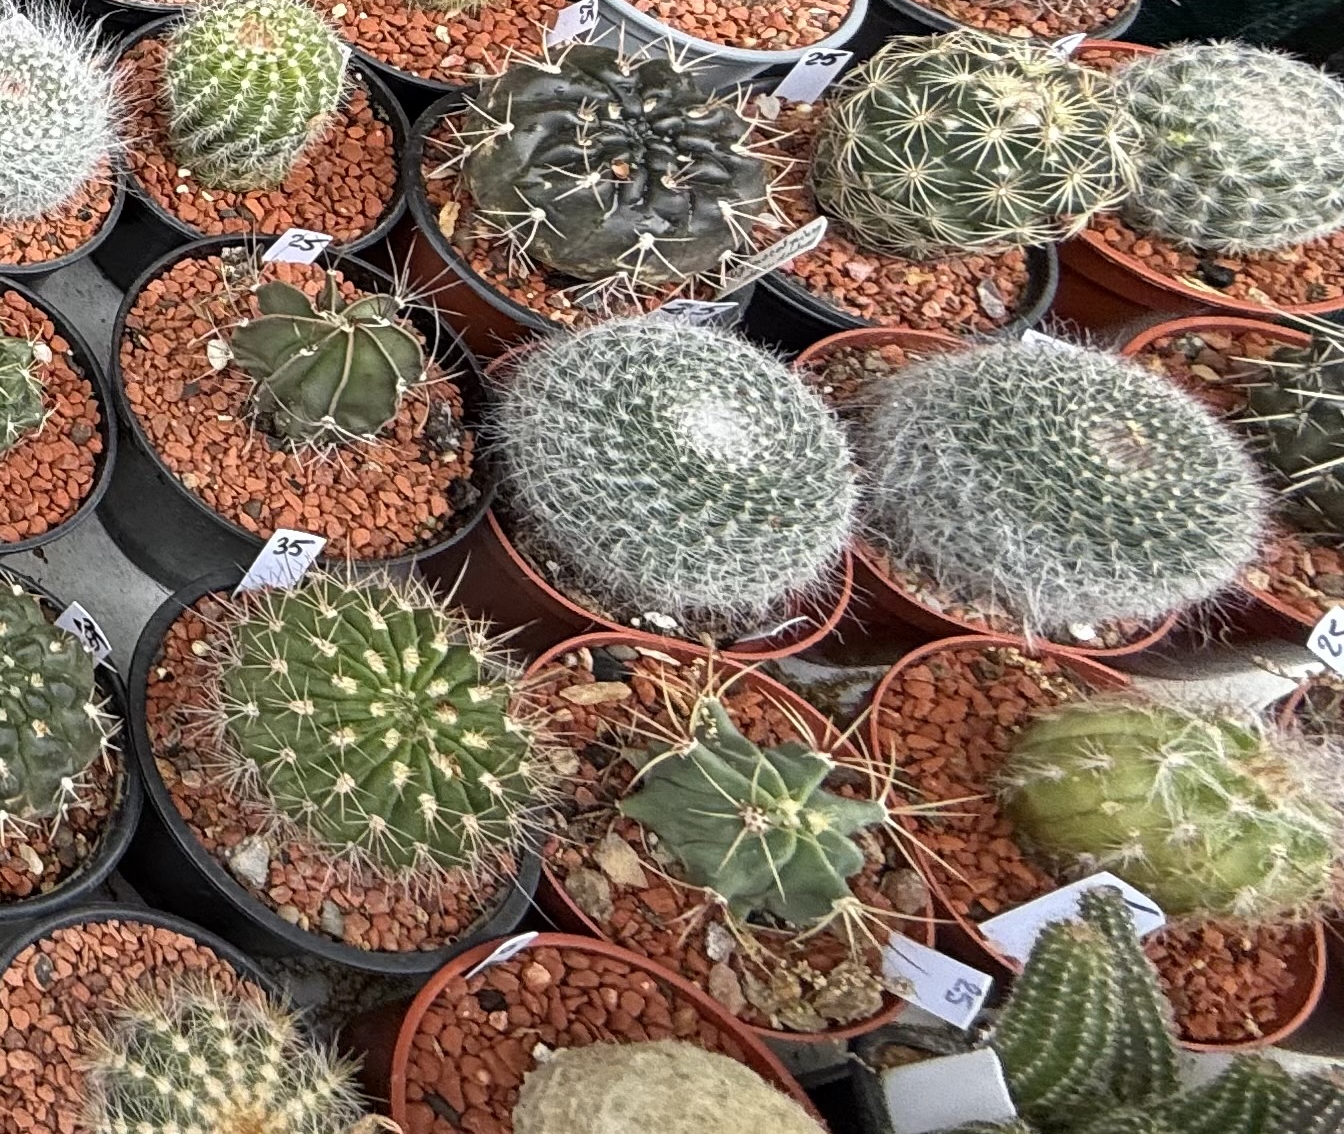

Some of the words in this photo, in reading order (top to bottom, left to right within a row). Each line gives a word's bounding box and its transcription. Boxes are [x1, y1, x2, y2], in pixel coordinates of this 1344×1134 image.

[805, 51, 847, 67] 25
[288, 234, 329, 251] 25
[273, 537, 315, 556] 35
